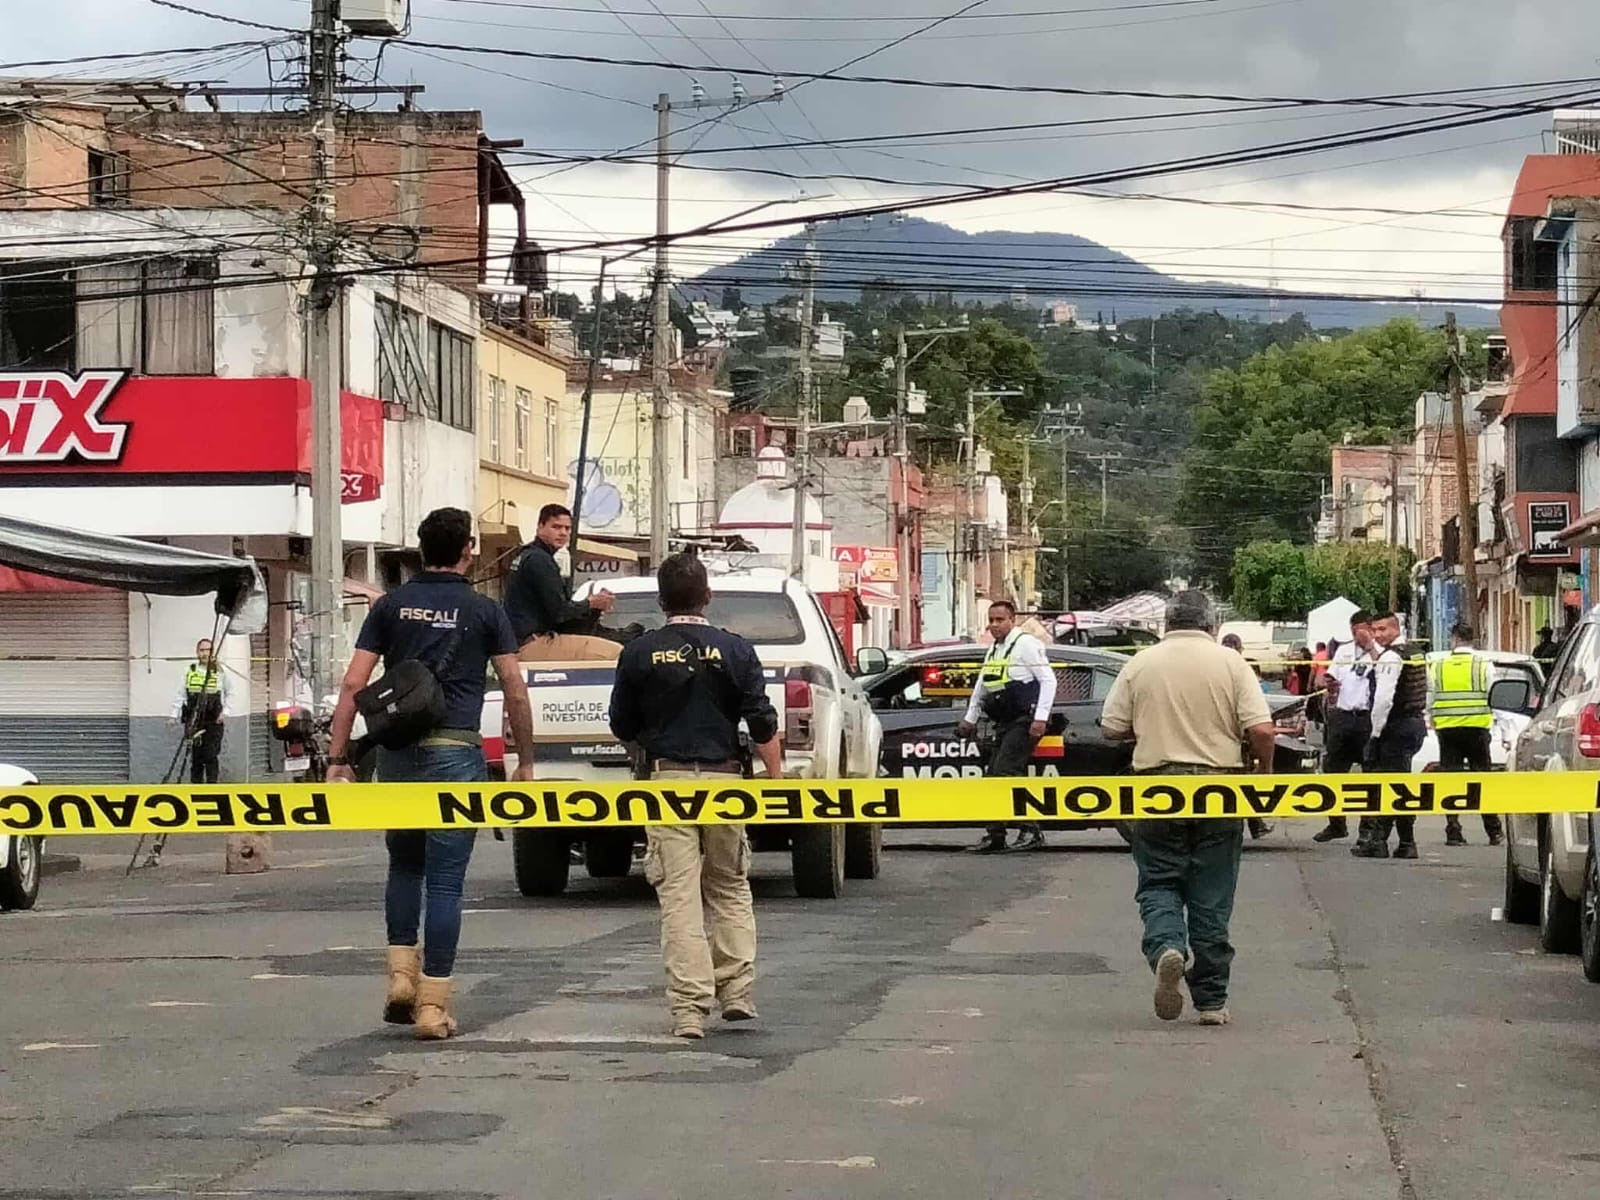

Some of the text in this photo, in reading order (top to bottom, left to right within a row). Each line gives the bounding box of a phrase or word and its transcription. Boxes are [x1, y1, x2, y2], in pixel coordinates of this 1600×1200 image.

[651, 645, 722, 665] FISCLÍA
[542, 700, 604, 712] POLICÍA DE
[901, 739, 981, 758] POLICÍA
[0, 793, 331, 829] PRECAUC
[437, 788, 901, 825] PRECAUCIÓN
[1012, 782, 1481, 817] PRECAUCIÓN
